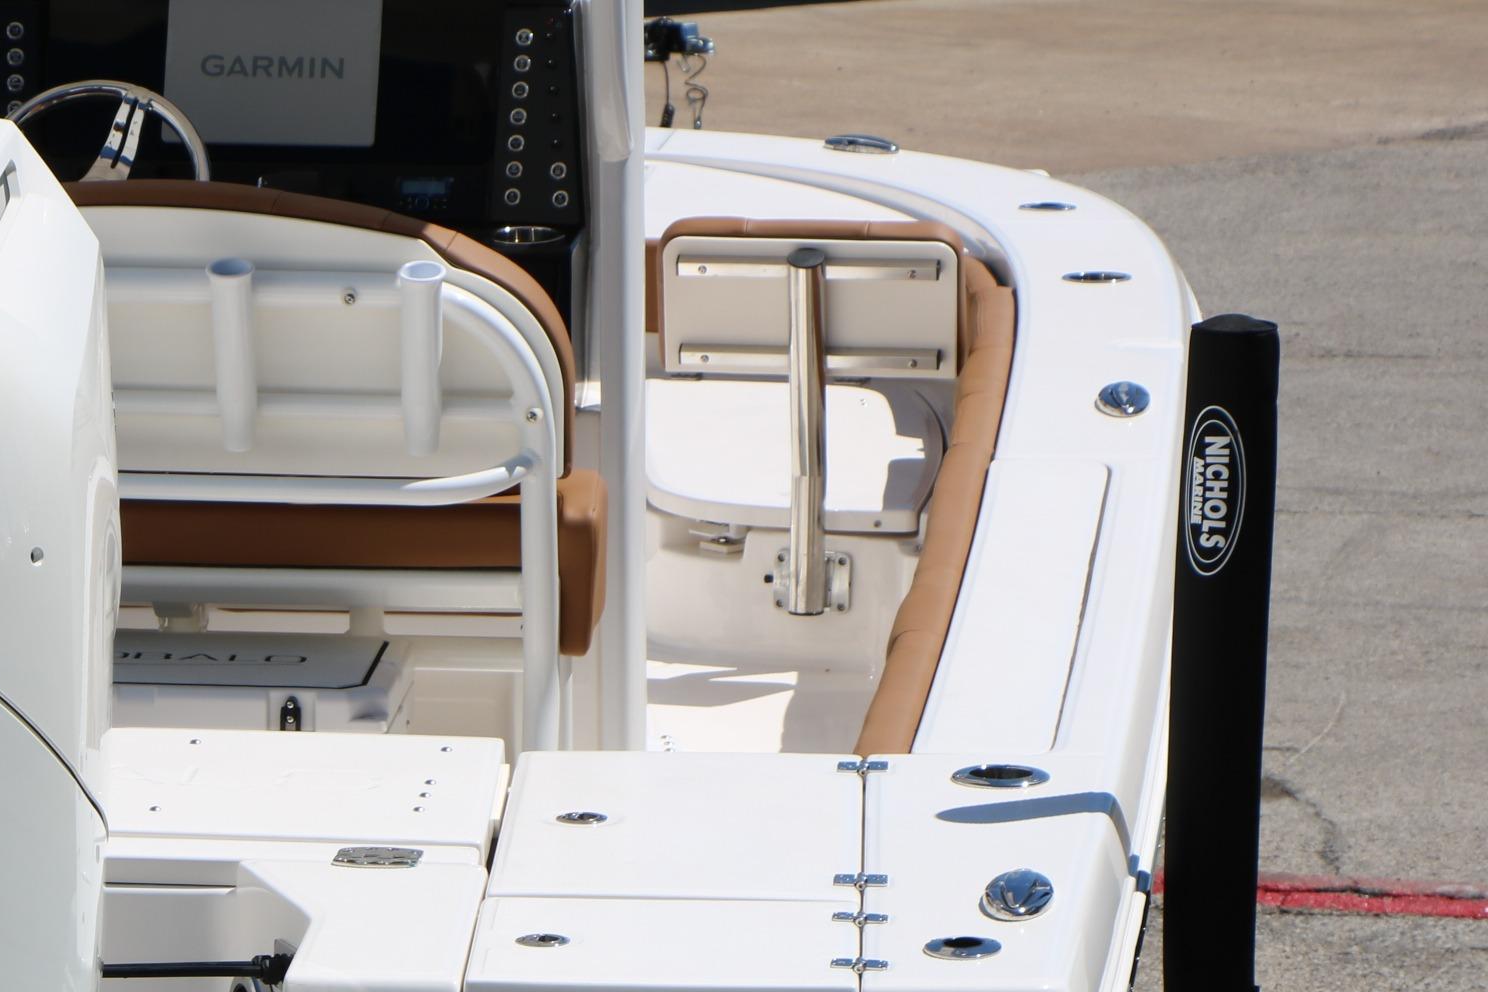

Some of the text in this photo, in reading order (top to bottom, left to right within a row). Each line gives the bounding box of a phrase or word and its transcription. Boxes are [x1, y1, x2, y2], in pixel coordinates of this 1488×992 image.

[200, 55, 345, 80] GARMIN
[1191, 456, 1205, 525] MARINE
[1199, 435, 1231, 549] NICHOLS
[116, 652, 308, 664] BALO
